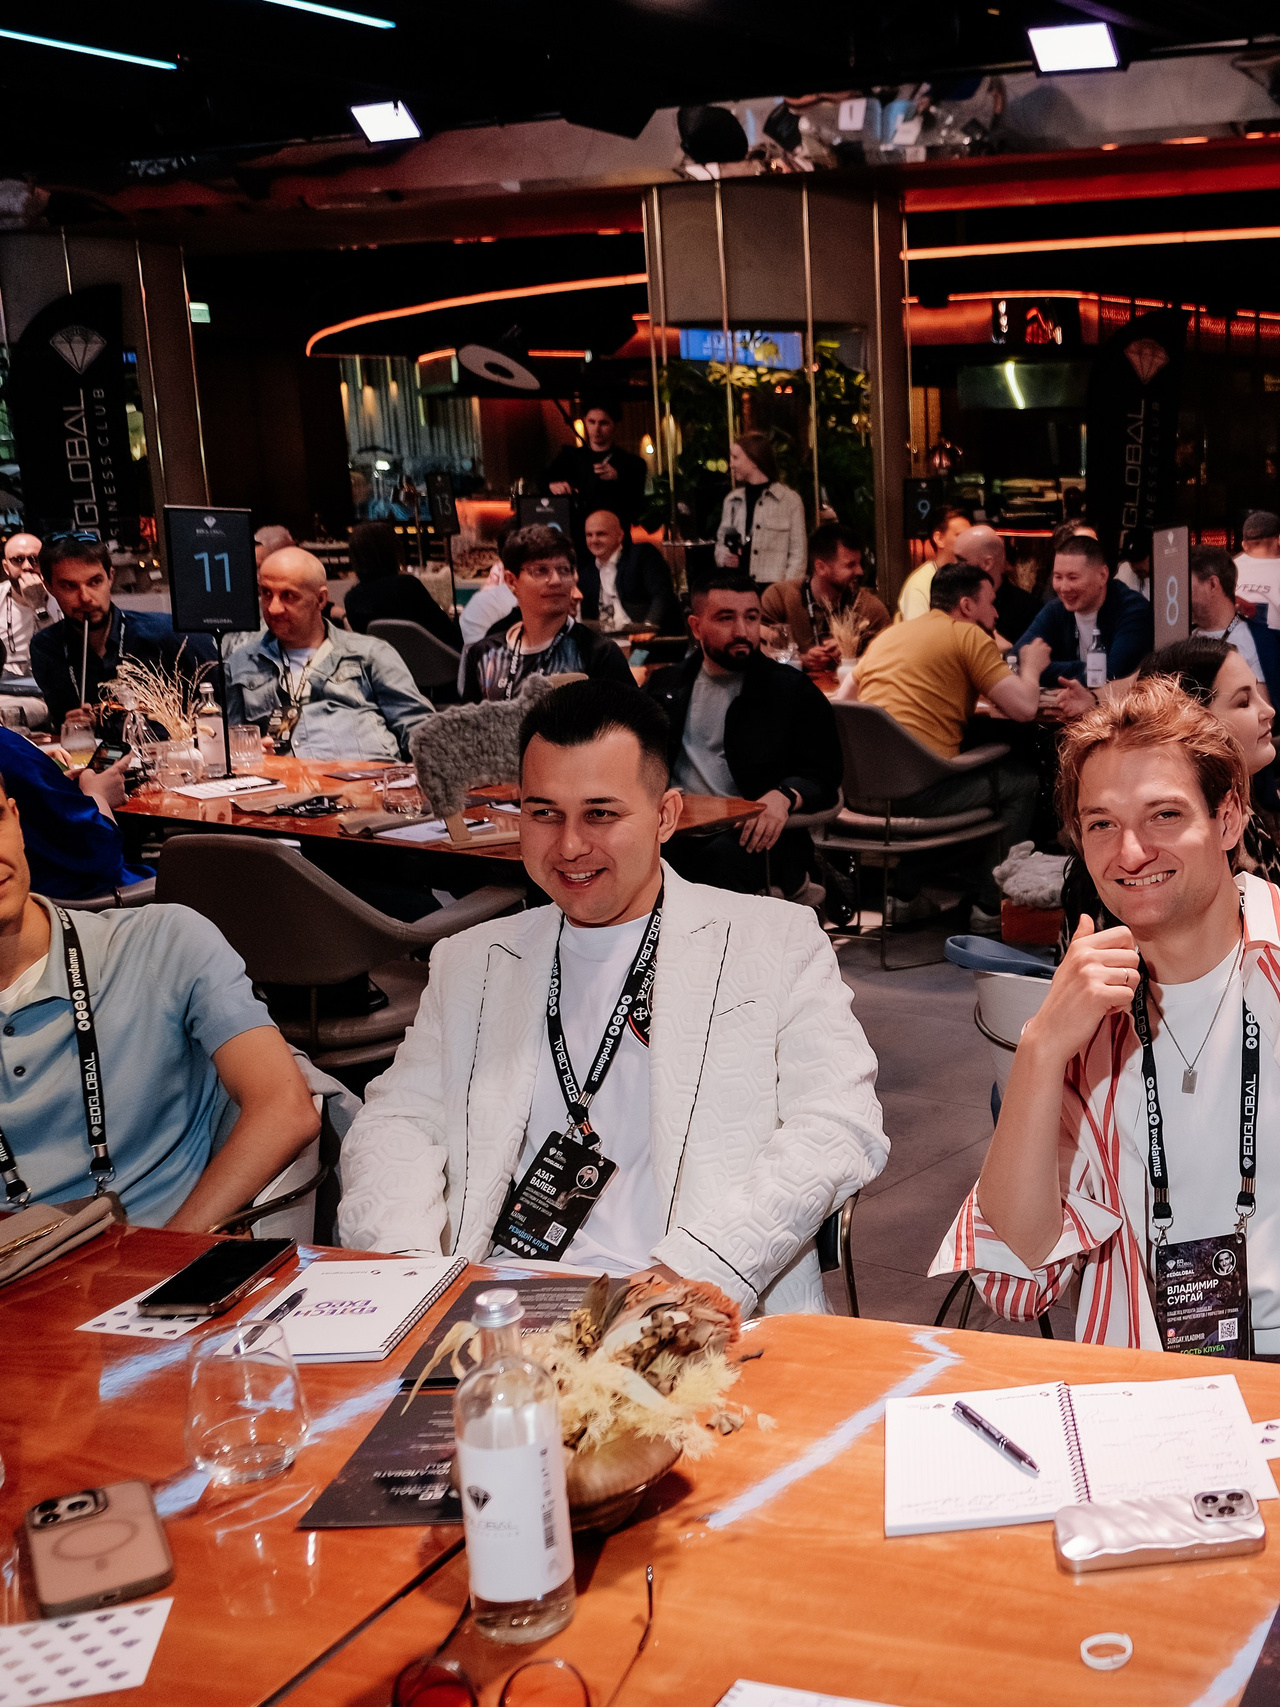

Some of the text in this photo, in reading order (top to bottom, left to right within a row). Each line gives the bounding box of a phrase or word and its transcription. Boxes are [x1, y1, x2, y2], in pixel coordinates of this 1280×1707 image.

[917, 499, 931, 520] 9
[193, 551, 232, 593] 11
[1165, 575, 1179, 626] 8
[632, 914, 662, 976] EDGLOBAL
[68, 947, 84, 988] prodamus
[553, 1034, 579, 1103] EDGLOBAL
[591, 1037, 615, 1082] prodamus
[84, 1051, 103, 1125] EDGLOBAL
[1243, 1073, 1257, 1156] EDGLOBAL
[1149, 1127, 1162, 1178] prodamus
[529, 1176, 557, 1196] ВАЛЕЕВ
[534, 1168, 555, 1183] АЗАТ
[531, 1237, 550, 1252] КЛУБА
[1166, 1269, 1195, 1278] #EDGLOBAL
[1167, 1279, 1219, 1295] ВЛАДИМИР
[1167, 1290, 1203, 1305] СУРГАЙ
[292, 1305, 378, 1318] EDTECH
[314, 1299, 373, 1309] EXPO
[1203, 1344, 1226, 1353] КЛУБА
